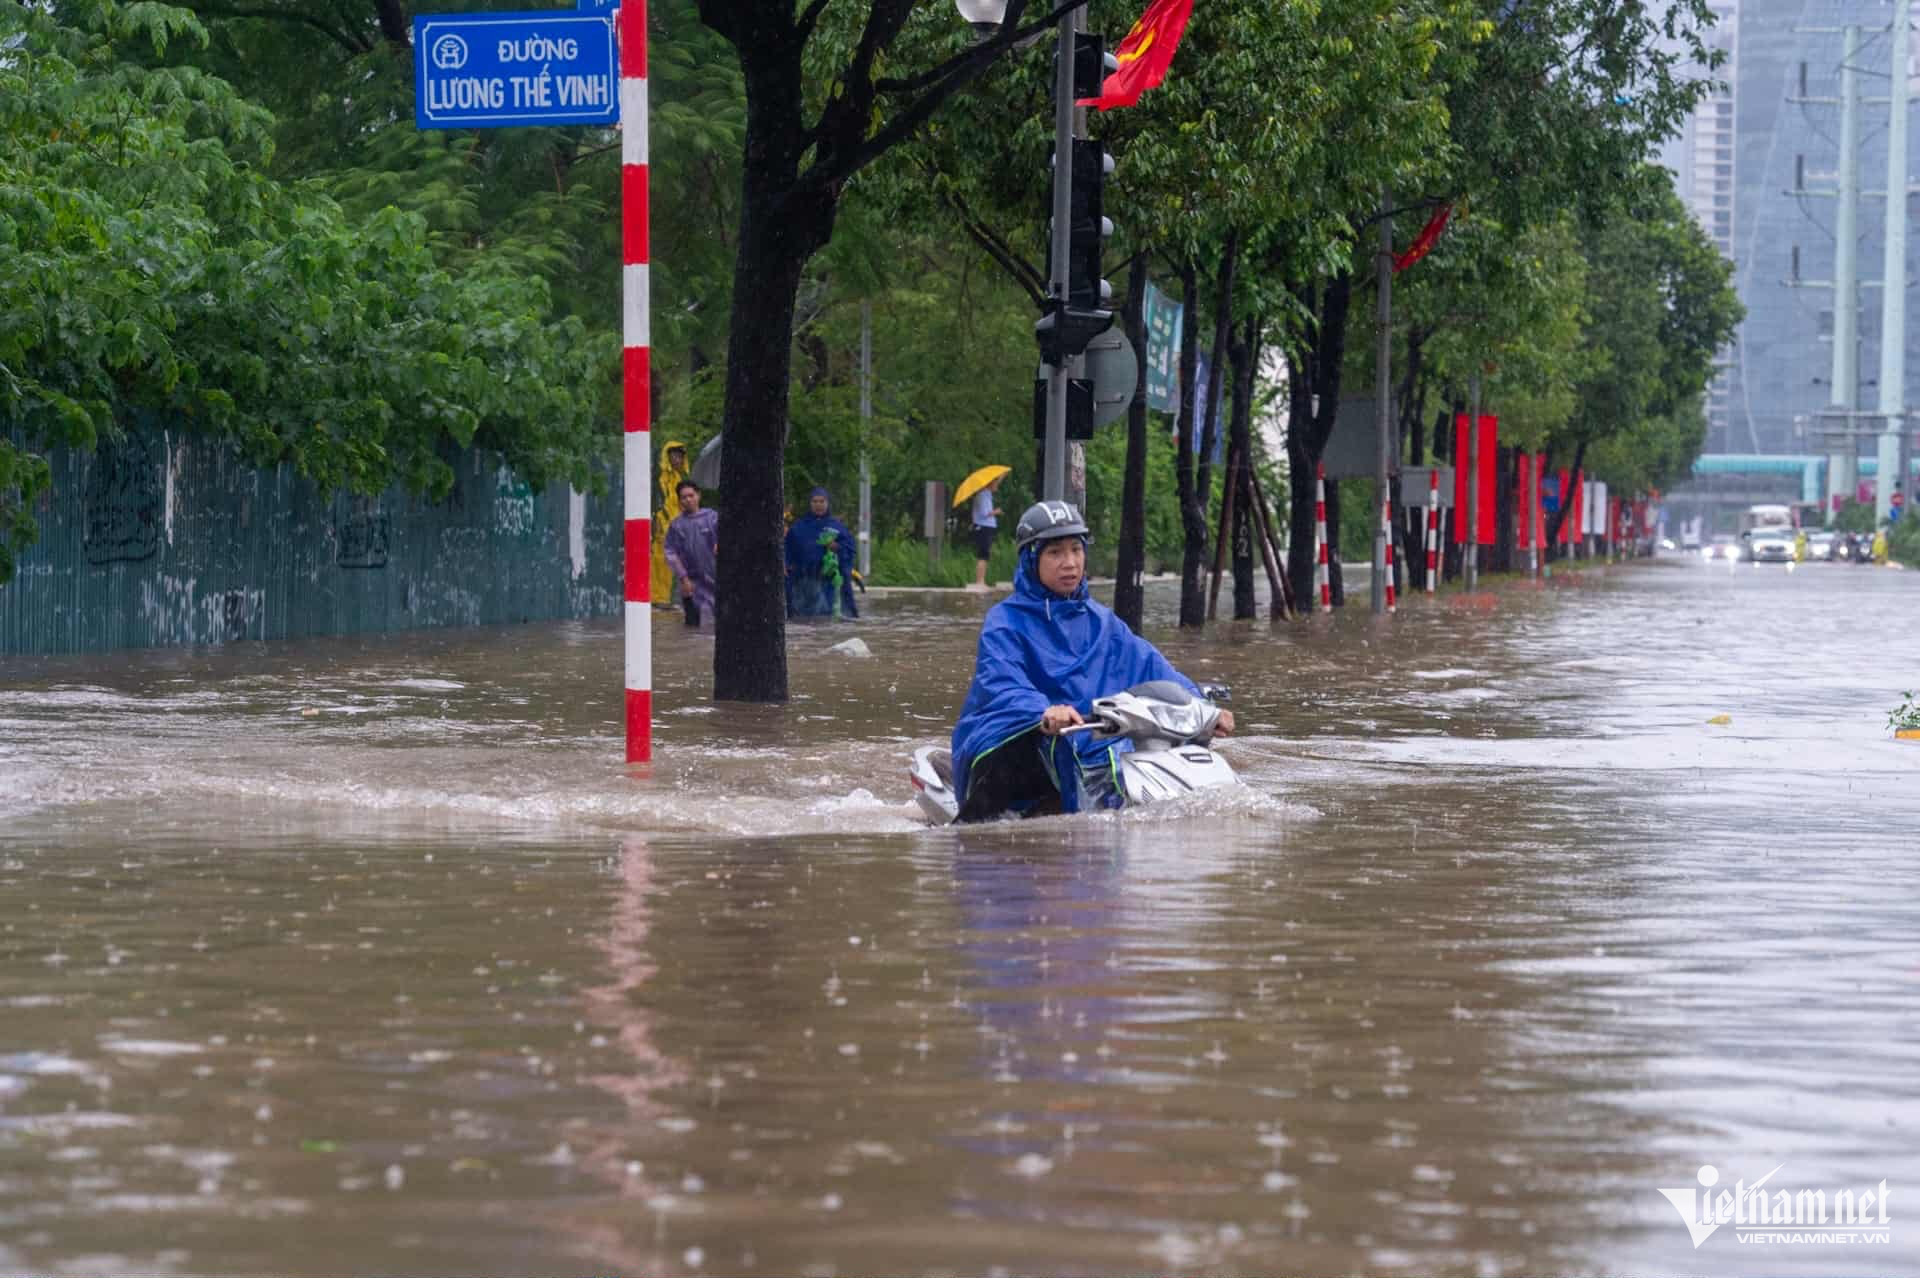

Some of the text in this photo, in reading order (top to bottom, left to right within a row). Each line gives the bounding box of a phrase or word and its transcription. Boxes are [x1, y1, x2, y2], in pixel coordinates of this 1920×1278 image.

[498, 33, 578, 62] ĐƯỜNG
[429, 63, 608, 110] LƯƠNG THẾ VINH
